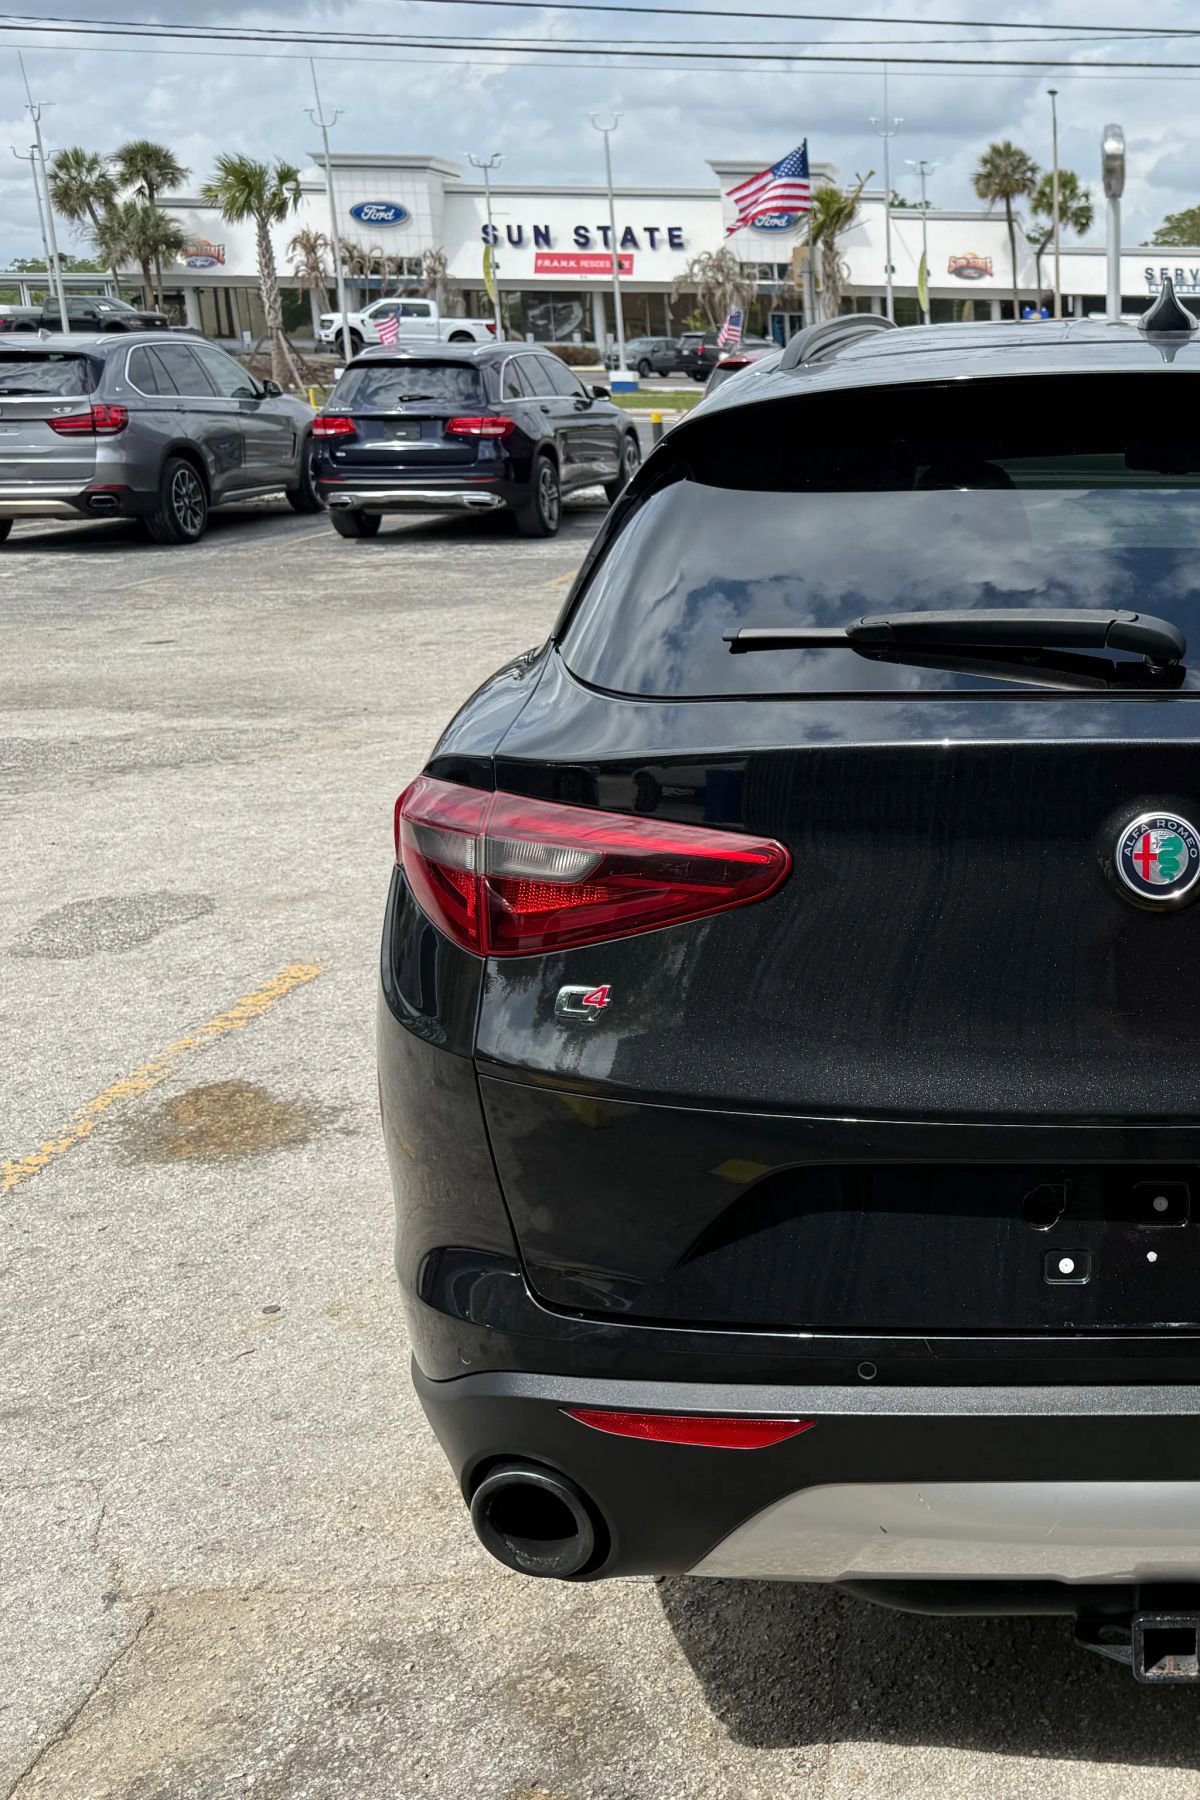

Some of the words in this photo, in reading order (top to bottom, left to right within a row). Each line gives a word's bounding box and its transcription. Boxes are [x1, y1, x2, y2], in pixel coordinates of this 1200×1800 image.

[361, 204, 395, 220] Ford
[754, 212, 788, 227] Ford
[481, 223, 551, 249] SUN
[572, 225, 685, 250] STATE
[1123, 823, 1150, 857] ALFA
[1156, 819, 1198, 859] ROMEO
[555, 984, 611, 1023] Q4
